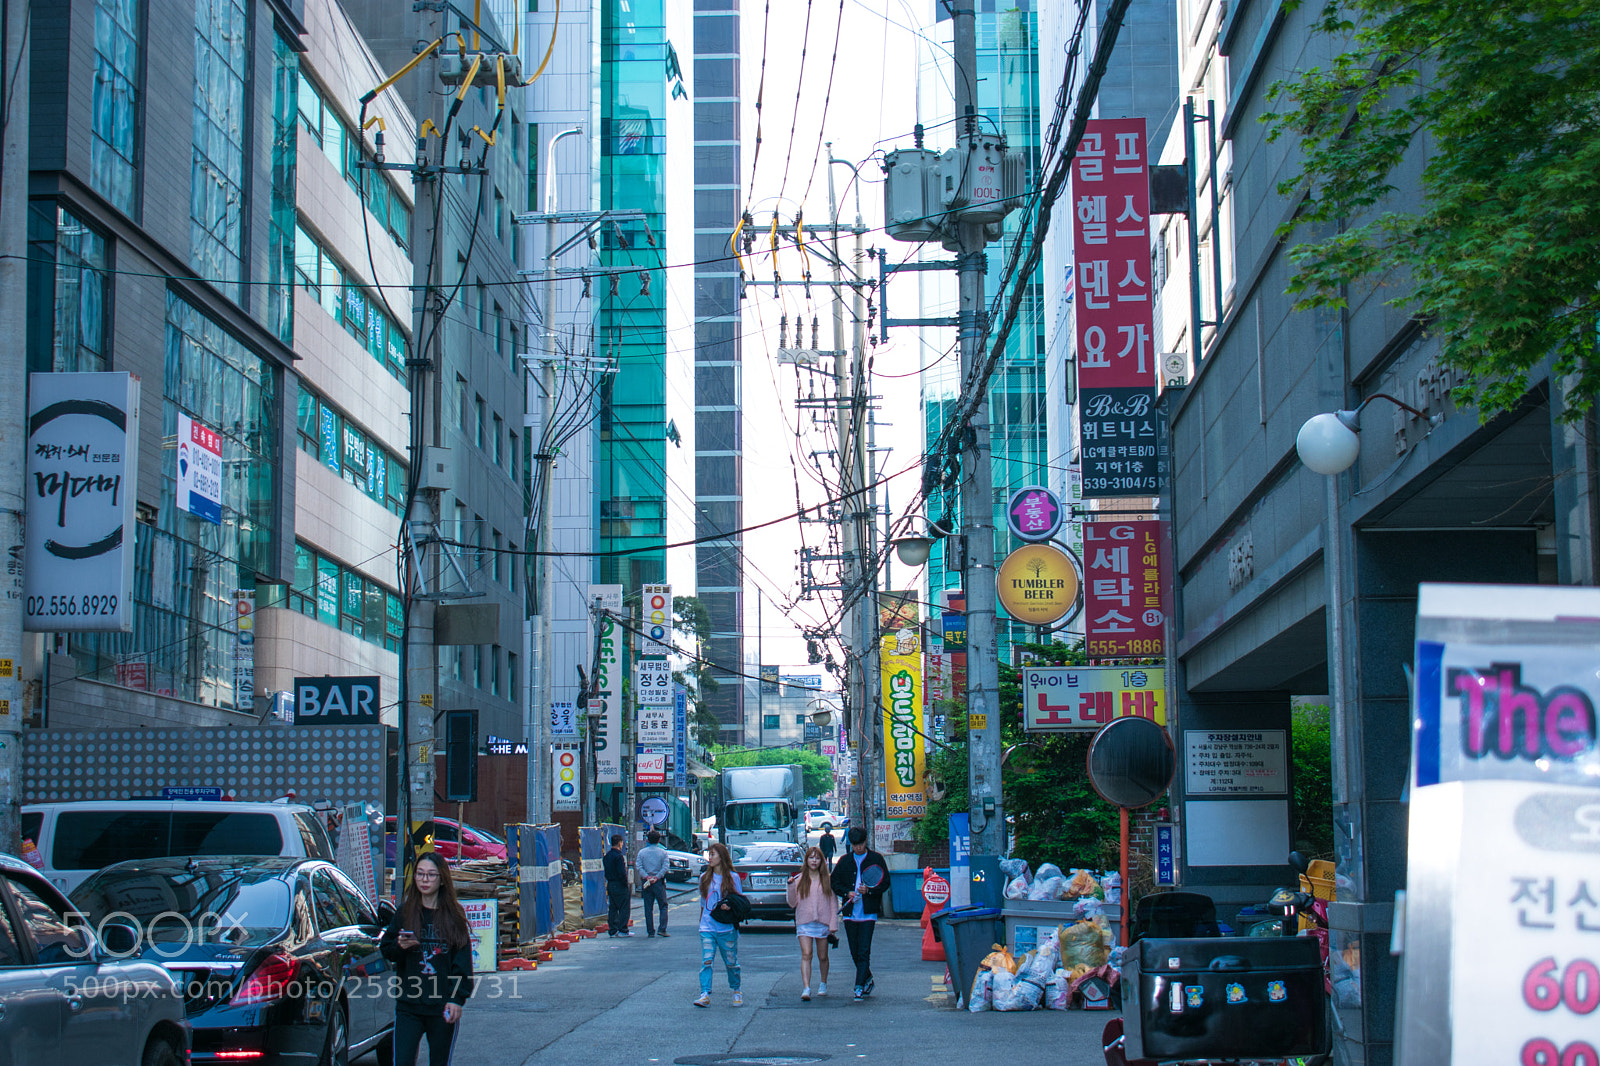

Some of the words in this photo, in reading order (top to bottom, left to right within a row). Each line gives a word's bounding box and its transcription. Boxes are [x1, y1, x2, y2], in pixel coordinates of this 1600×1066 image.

[1076, 133, 1142, 182] 골프
[1077, 195, 1145, 244] 헬스
[1079, 259, 1147, 309] 댄스
[1081, 323, 1149, 373] 요가
[1085, 394, 1150, 417] B&B
[1083, 421, 1154, 440] 휘트니스
[93, 453, 120, 463] 전문점
[1084, 477, 1156, 490] 539-3104/5
[1024, 497, 1044, 531] 부동산
[1087, 525, 1135, 541] LG
[1011, 578, 1065, 589] TUMBLER
[1090, 546, 1136, 634] 세탁소
[1024, 589, 1054, 600] BEER
[27, 595, 118, 616] 02.556.8929
[1145, 611, 1161, 624] B1
[1089, 640, 1162, 657] 555-1886
[640, 662, 670, 671] 세무법인
[640, 673, 669, 687] 정상
[1030, 674, 1079, 690] 웨이브
[1121, 671, 1148, 688] 1층
[299, 685, 374, 716] BAR
[1449, 663, 1597, 758] The
[888, 805, 926, 816] 568-5001
